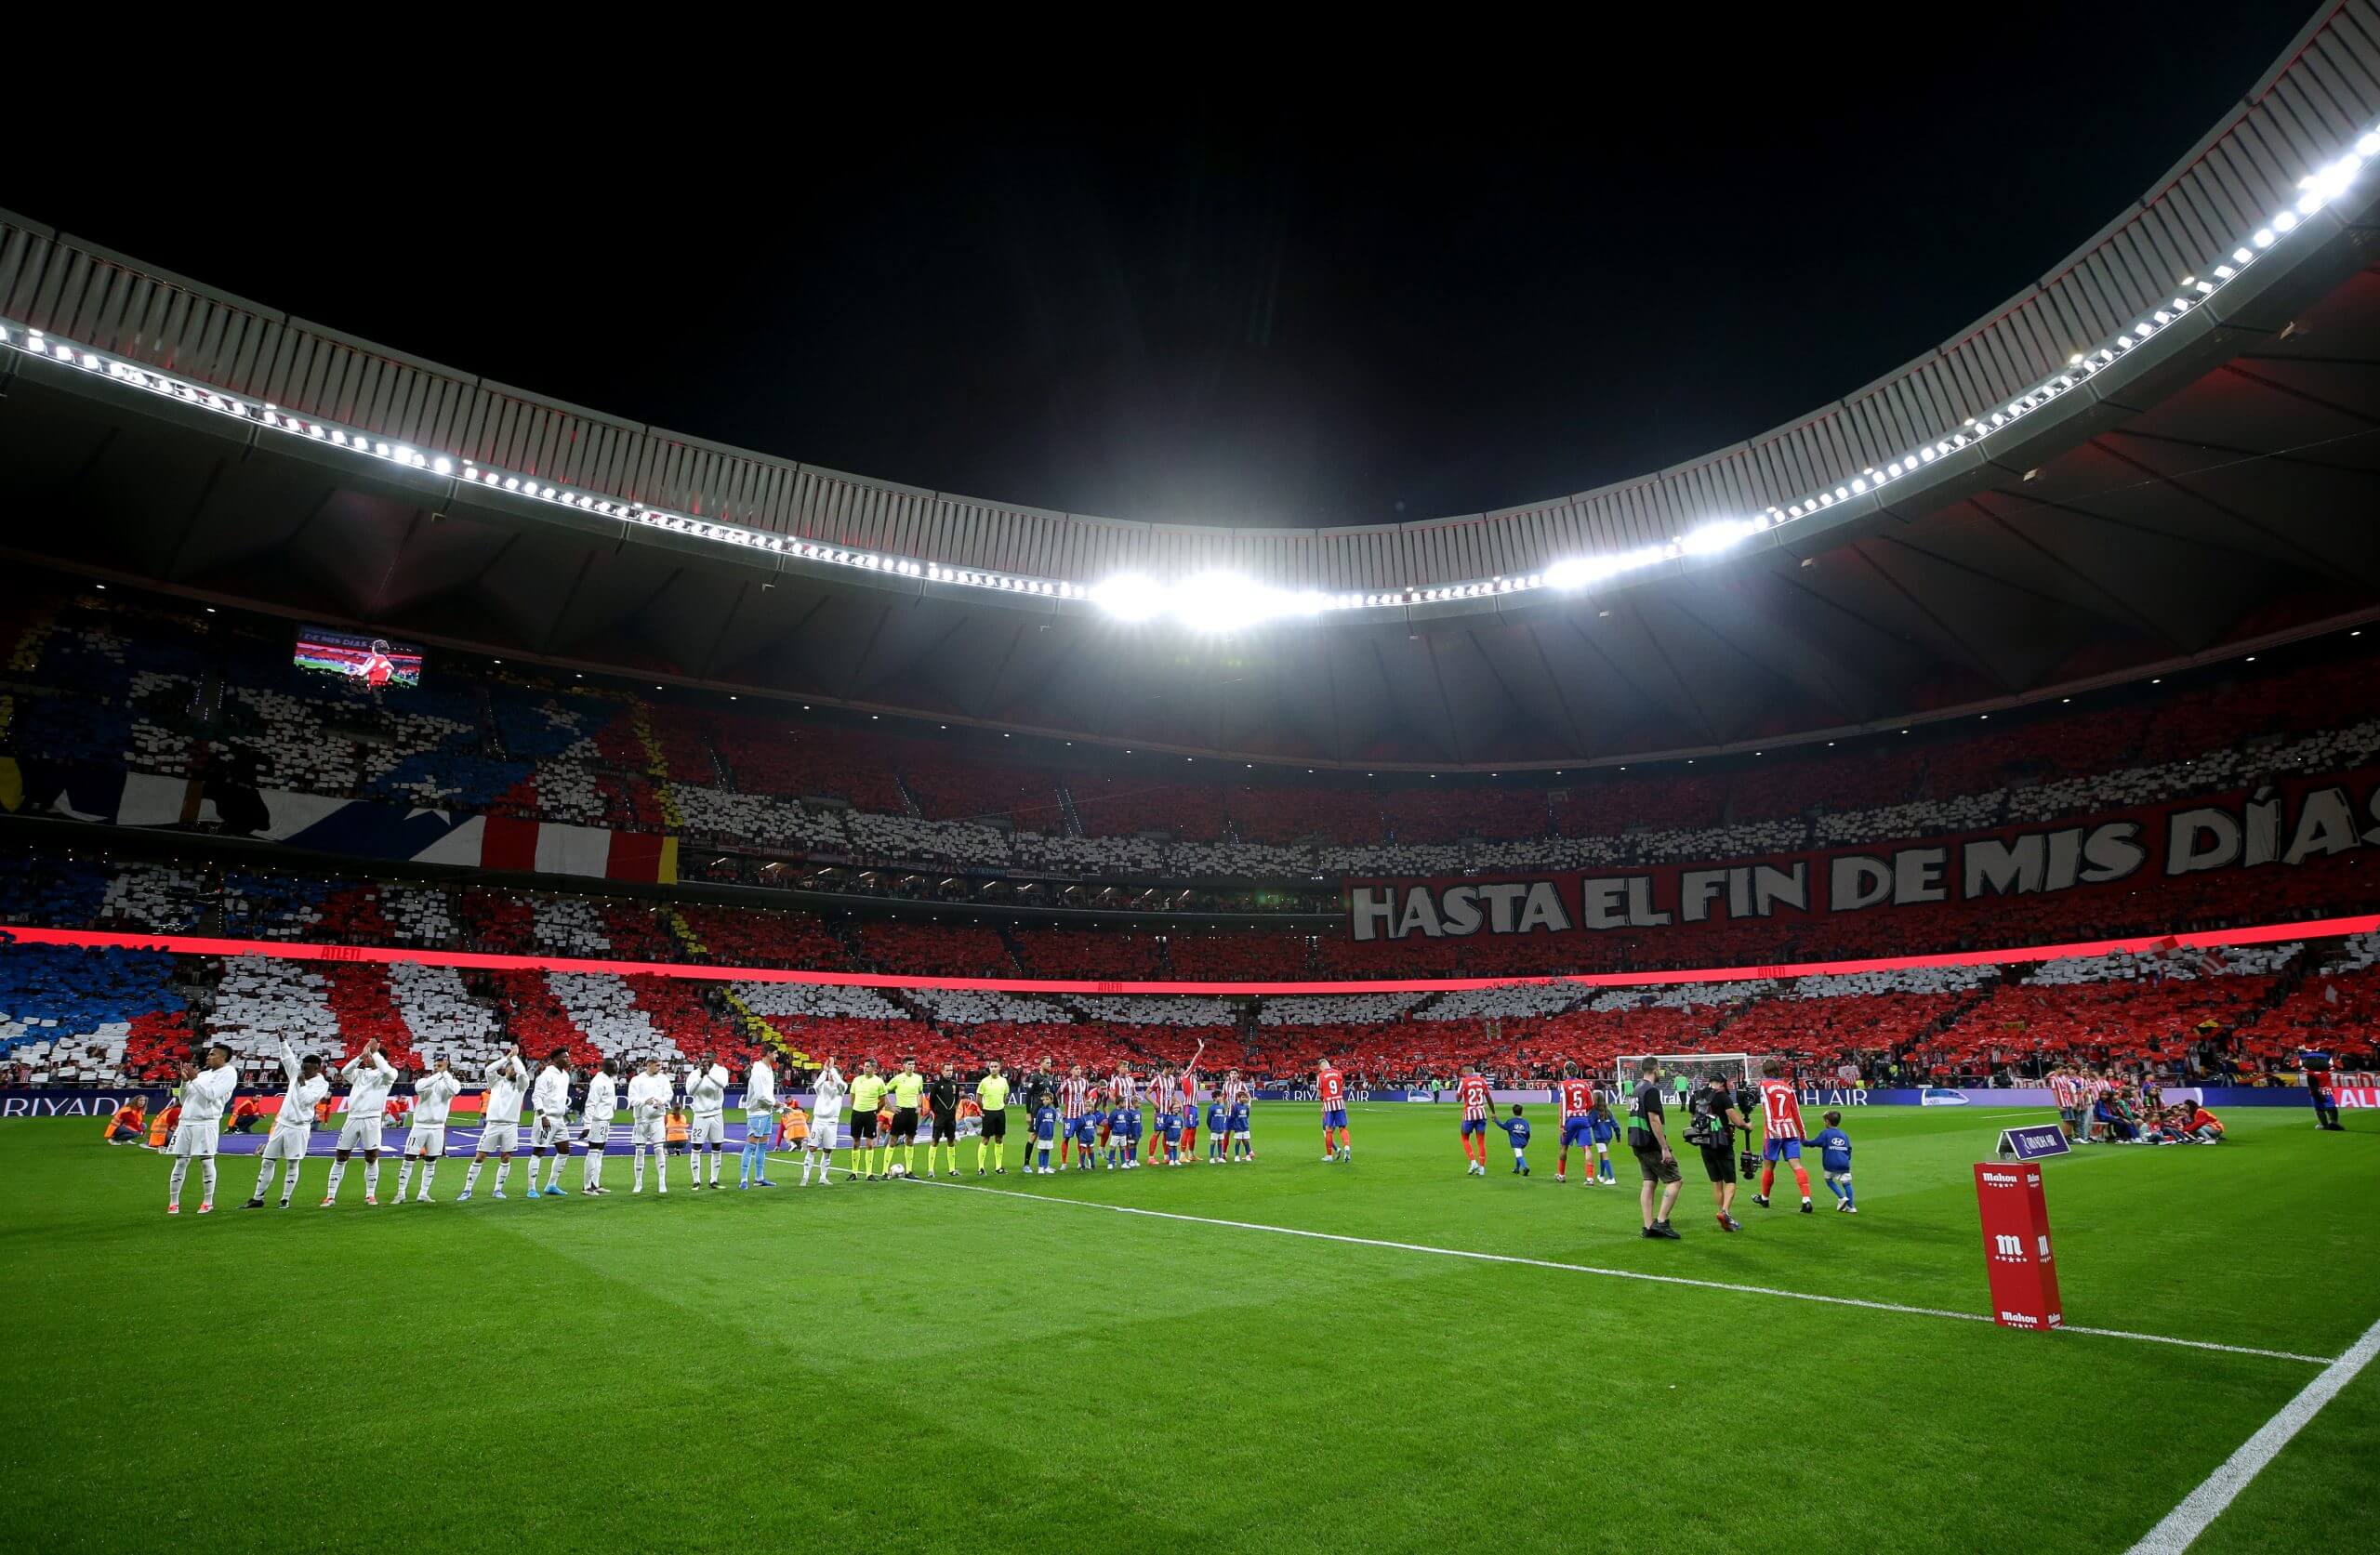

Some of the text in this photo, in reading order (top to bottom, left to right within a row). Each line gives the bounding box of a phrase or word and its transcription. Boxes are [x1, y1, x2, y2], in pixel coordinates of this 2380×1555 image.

[1352, 882, 1571, 941] HASTA
[1583, 876, 1672, 929] EL
[1682, 862, 1806, 922] FIN
[1831, 848, 1946, 912] DE
[1964, 822, 2144, 899] MIS
[321, 946, 361, 960] ATLETI
[1329, 1079, 1339, 1095] 9
[1348, 1090, 1369, 1102] AIR
[1468, 1087, 1484, 1105] 23
[1573, 1090, 1583, 1109] 5
[1830, 1089, 1868, 1106] AIR
[1776, 1093, 1786, 1116] 7
[693, 1128, 703, 1138] 22
[1982, 1172, 2018, 1183] Mahou
[1995, 1234, 2023, 1256] m
[2001, 1311, 2038, 1324] Mahou
